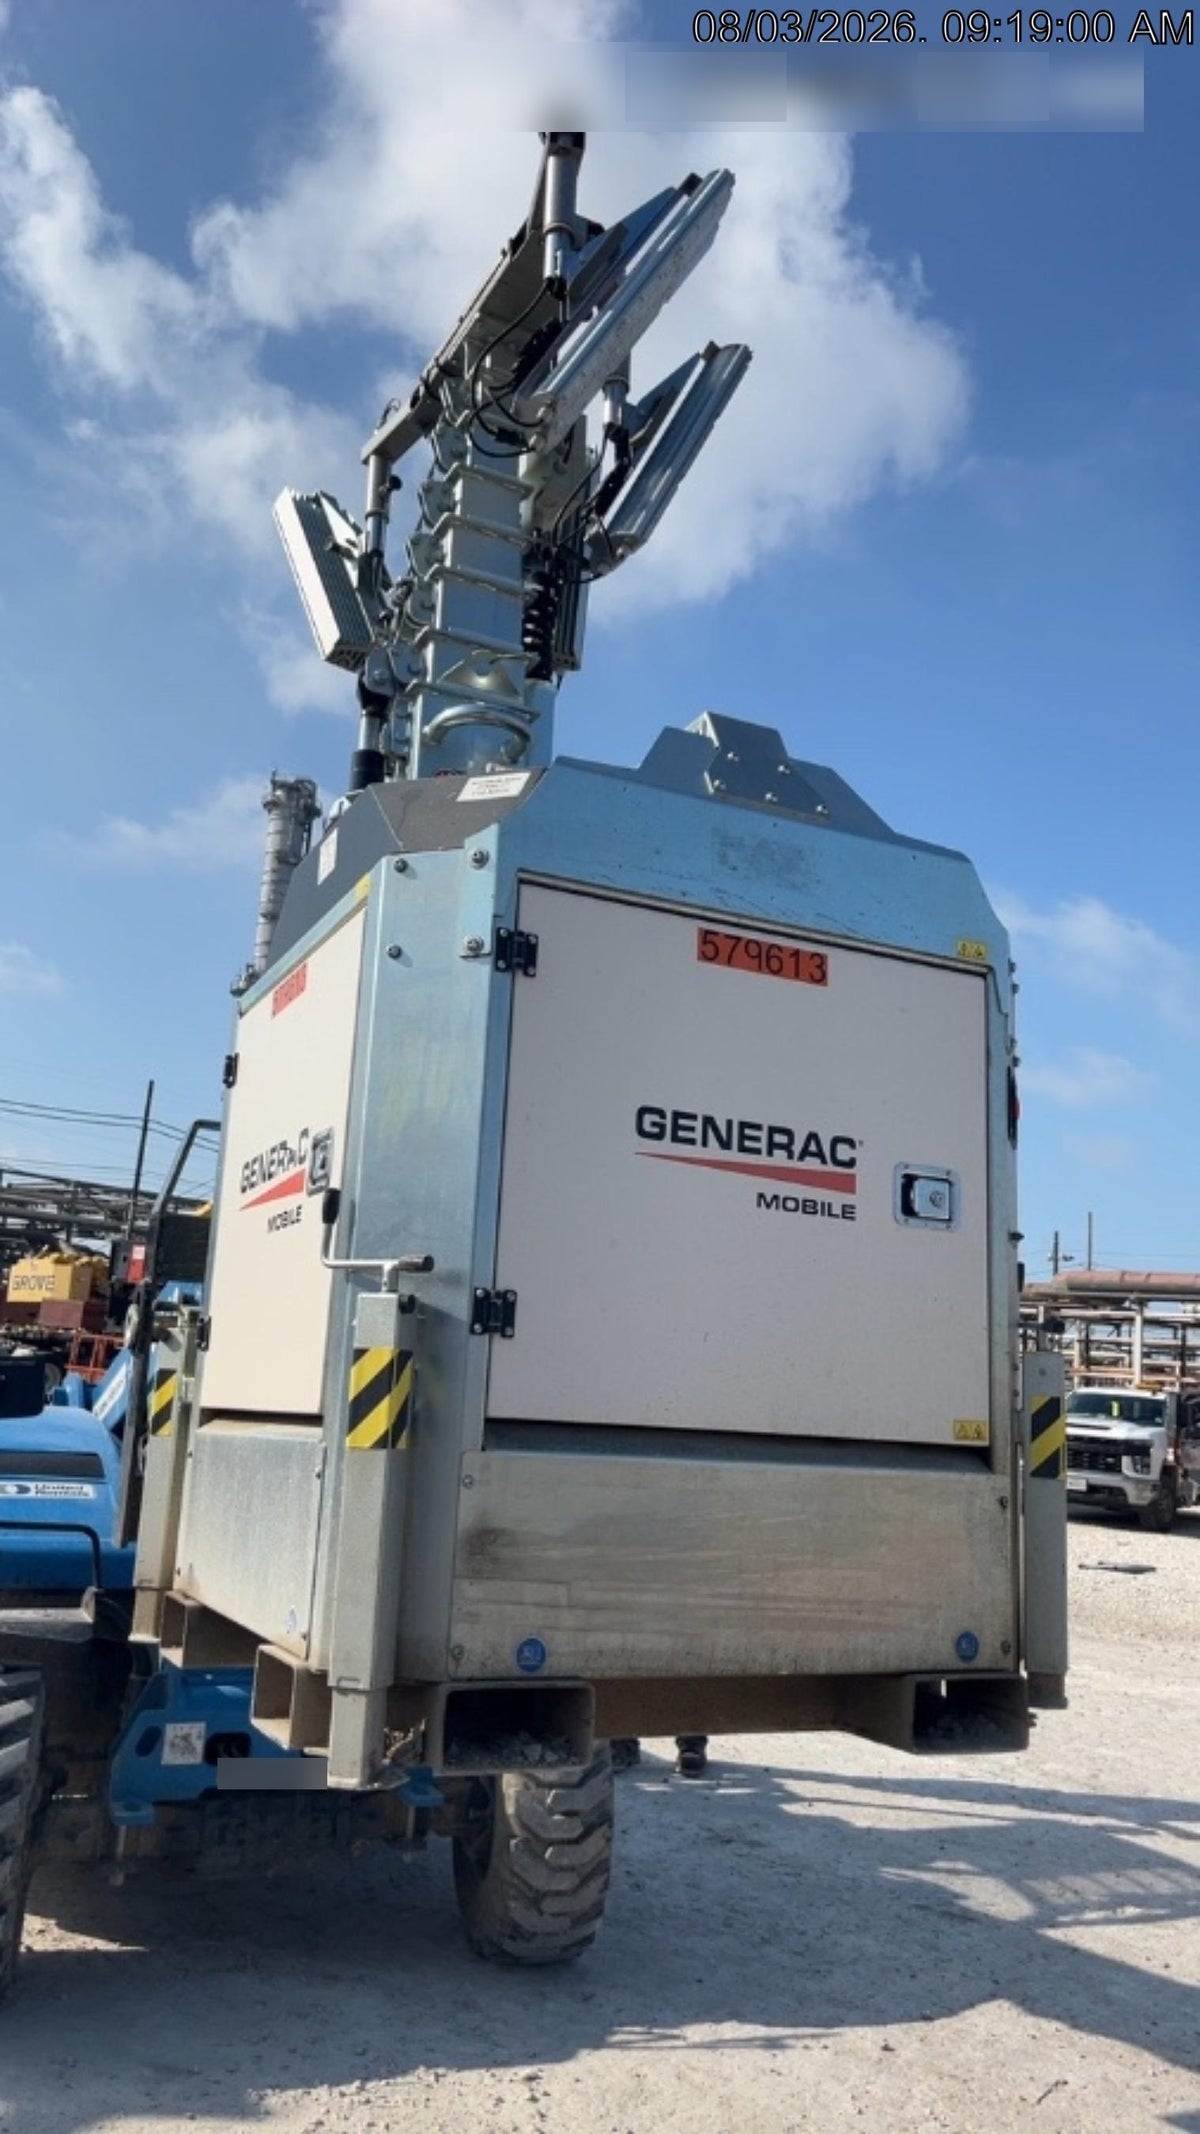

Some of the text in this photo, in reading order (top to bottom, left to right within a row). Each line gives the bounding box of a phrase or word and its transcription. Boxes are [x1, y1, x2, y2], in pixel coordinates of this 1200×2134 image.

[701, 929, 826, 983] 579613
[635, 1105, 857, 1169] GENERAC
[240, 1127, 309, 1194] GENERAC
[267, 1204, 302, 1233] MOBILE
[756, 1192, 856, 1221] MOBILE
[12, 1275, 56, 1291] GROVE
